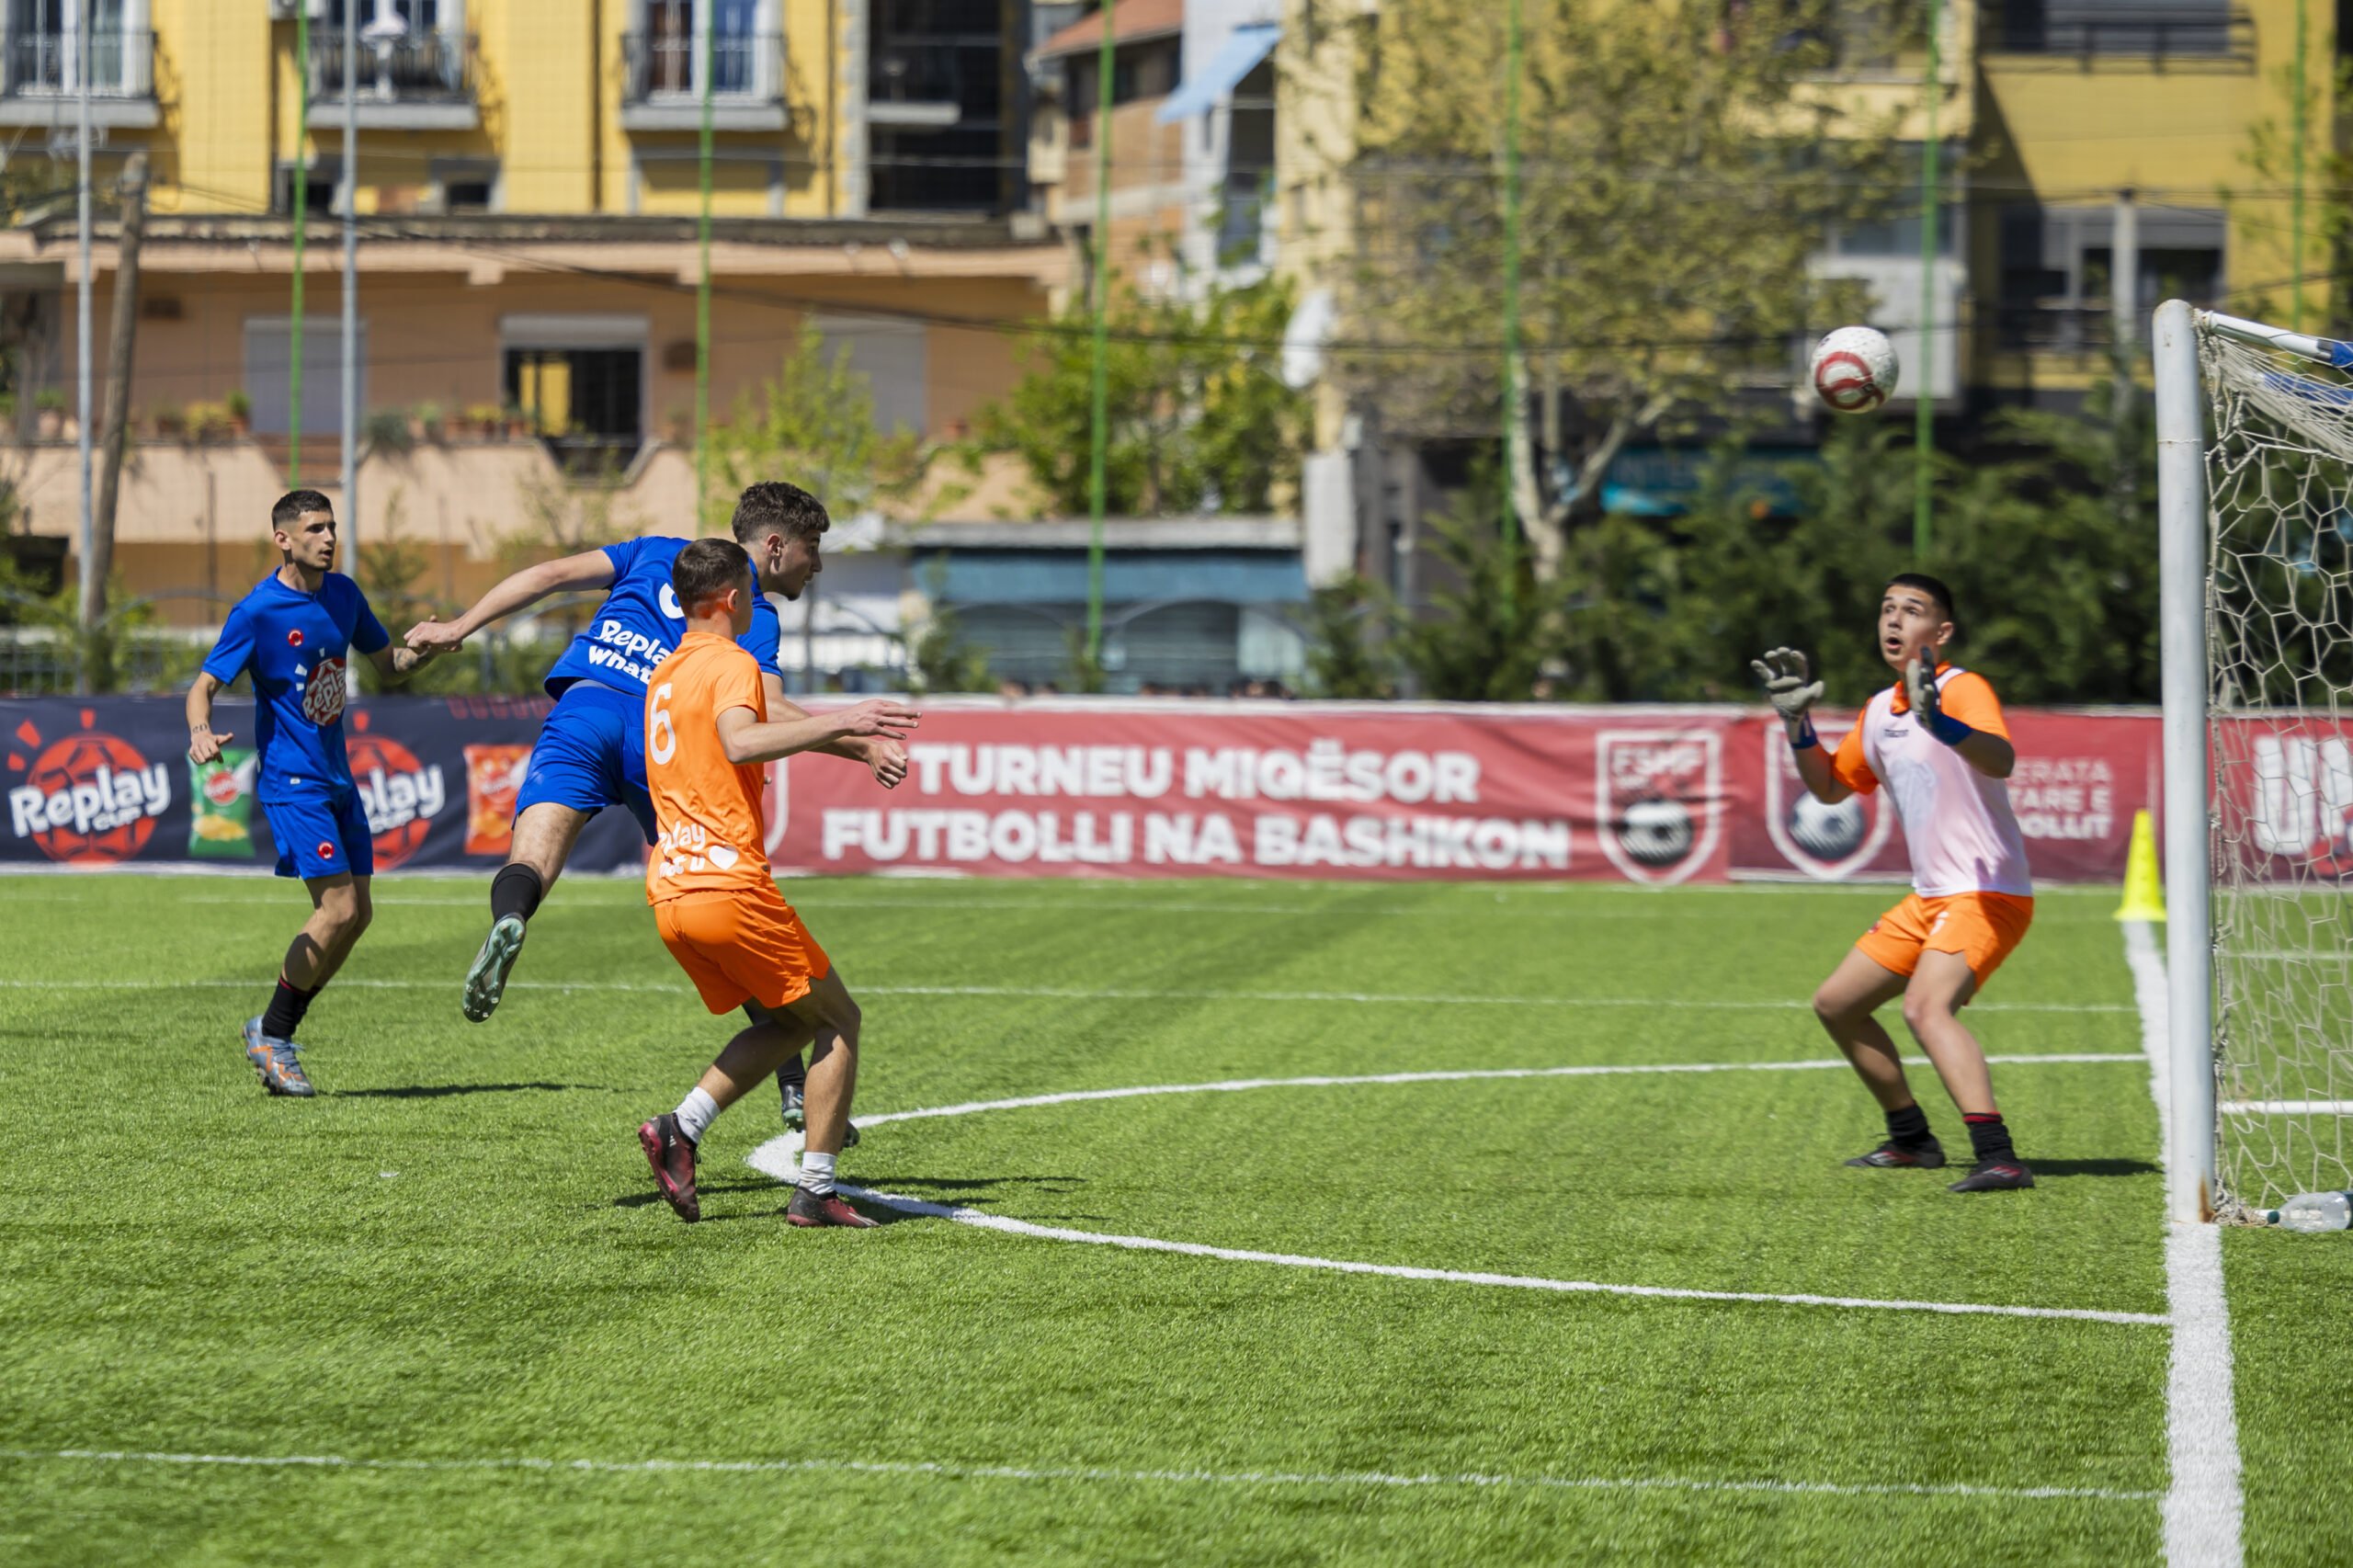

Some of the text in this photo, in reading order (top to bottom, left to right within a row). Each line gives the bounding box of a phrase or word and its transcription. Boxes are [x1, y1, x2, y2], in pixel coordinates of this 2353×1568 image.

[650, 683, 676, 765] 6
[9, 762, 172, 837] Replay
[910, 744, 1172, 798] TURNEU
[2091, 788, 2111, 812] E
[823, 809, 1571, 869] FUTBOLLI NA BASHKON
